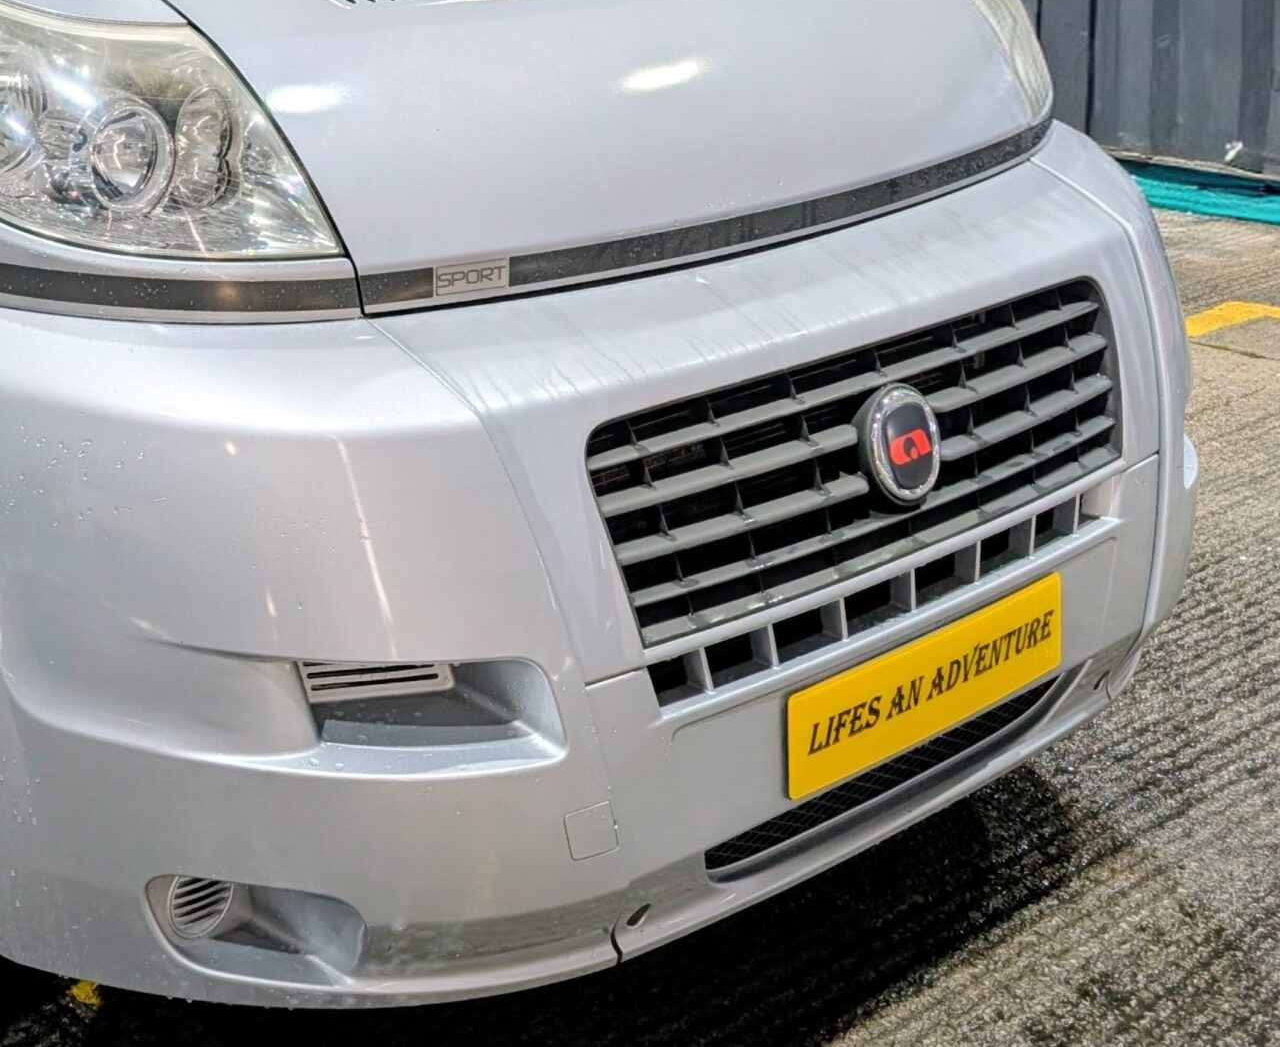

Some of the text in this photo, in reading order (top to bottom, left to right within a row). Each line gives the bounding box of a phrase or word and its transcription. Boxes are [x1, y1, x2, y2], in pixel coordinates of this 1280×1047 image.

[436, 264, 507, 289] SPORT
[807, 608, 1055, 757] LIFES AN ADVENTURE
